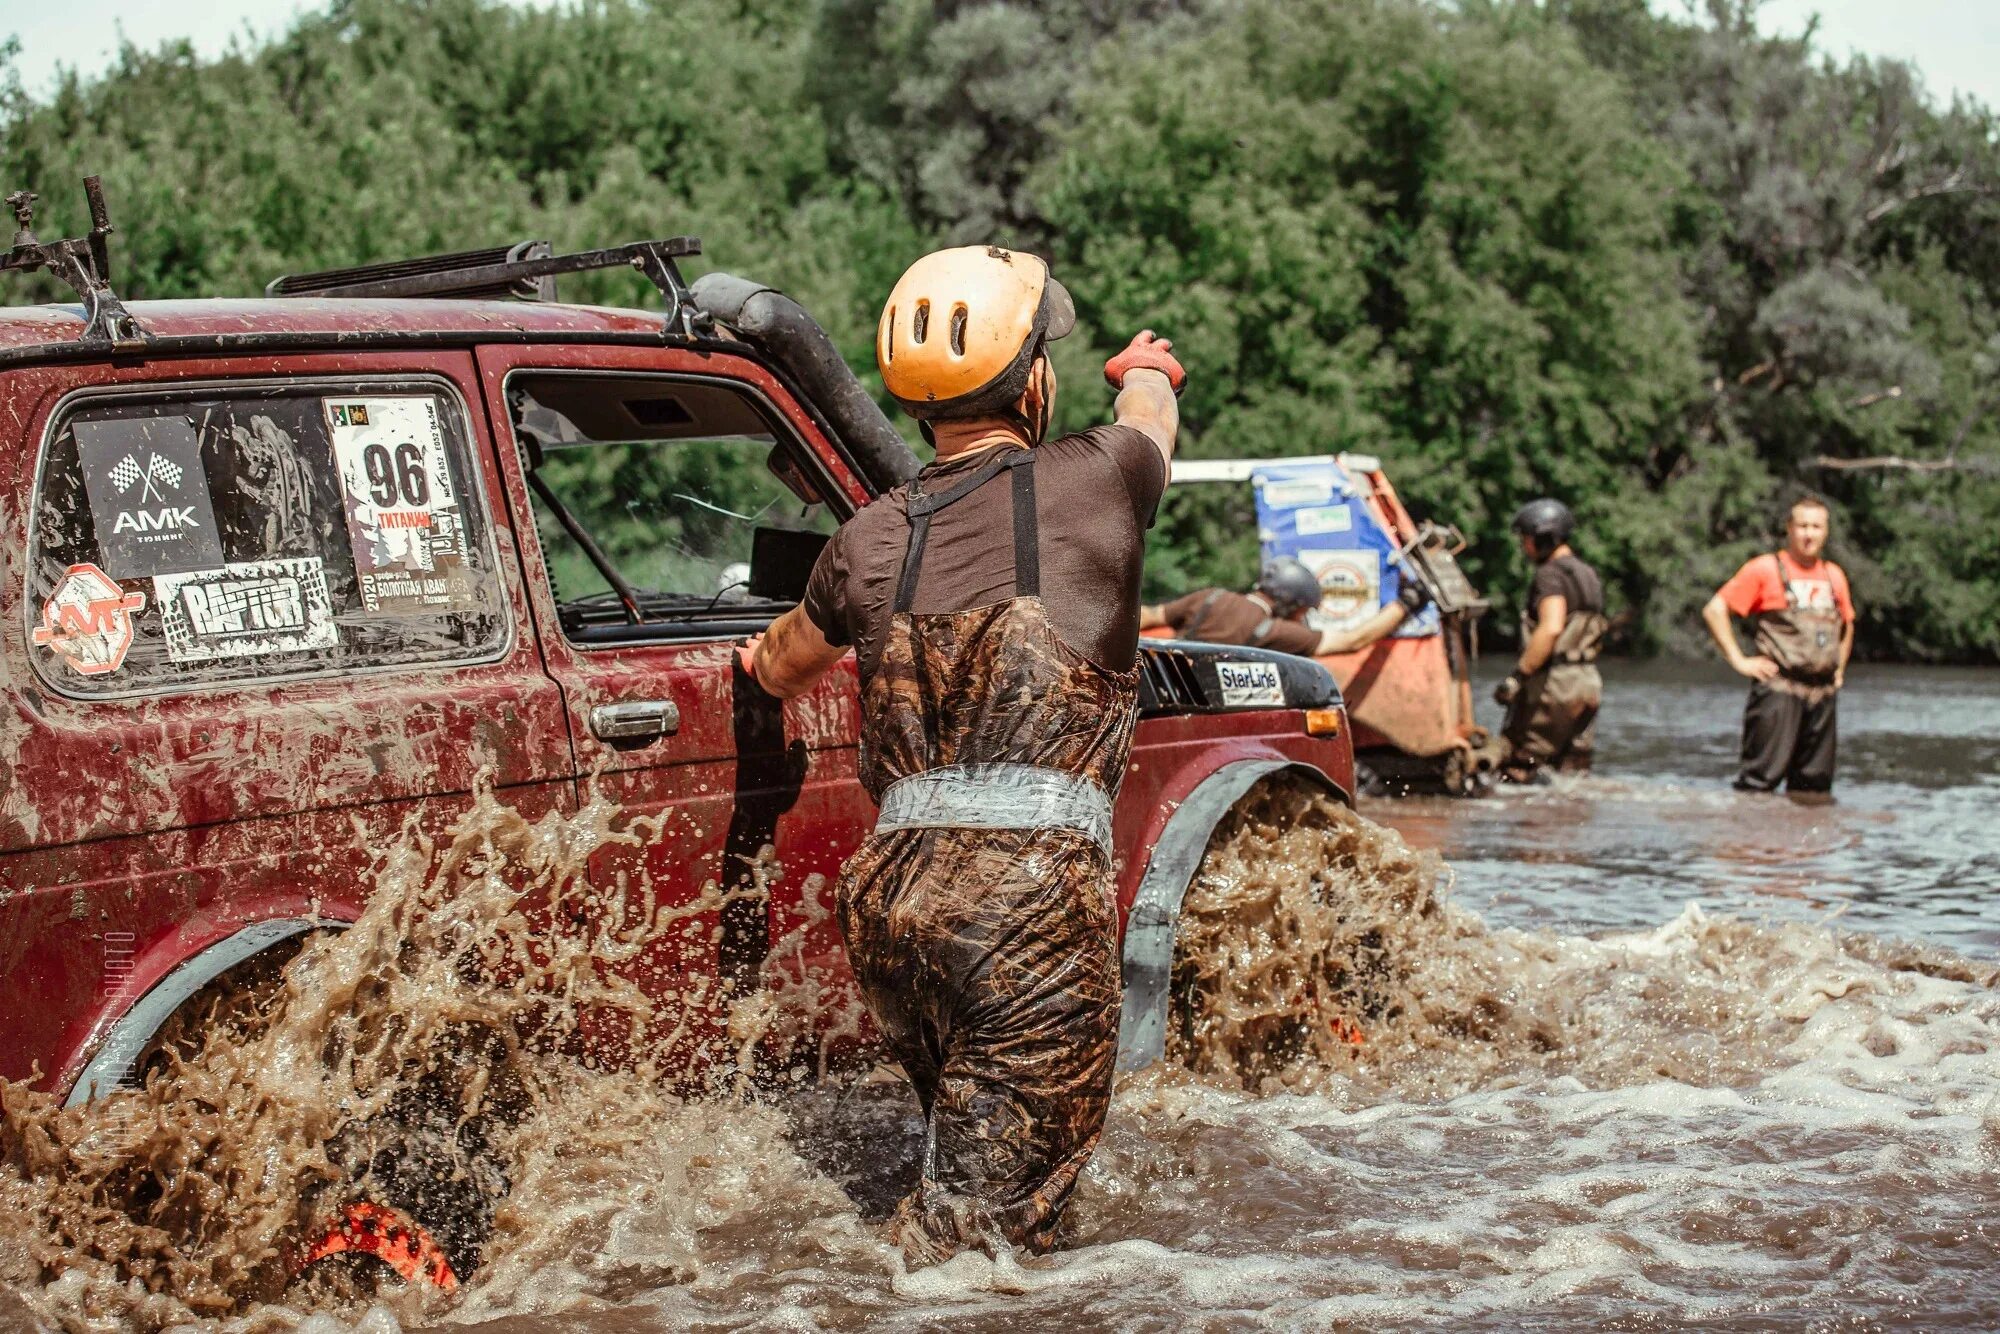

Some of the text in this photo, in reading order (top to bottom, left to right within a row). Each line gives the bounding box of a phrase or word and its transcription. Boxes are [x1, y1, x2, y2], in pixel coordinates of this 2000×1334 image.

[364, 443, 429, 508] 96
[181, 578, 305, 634] RAPTOR
[363, 574, 380, 612] 2020
[377, 580, 423, 598] БОЛОТНАЯ
[1222, 667, 1276, 688] StarLine
